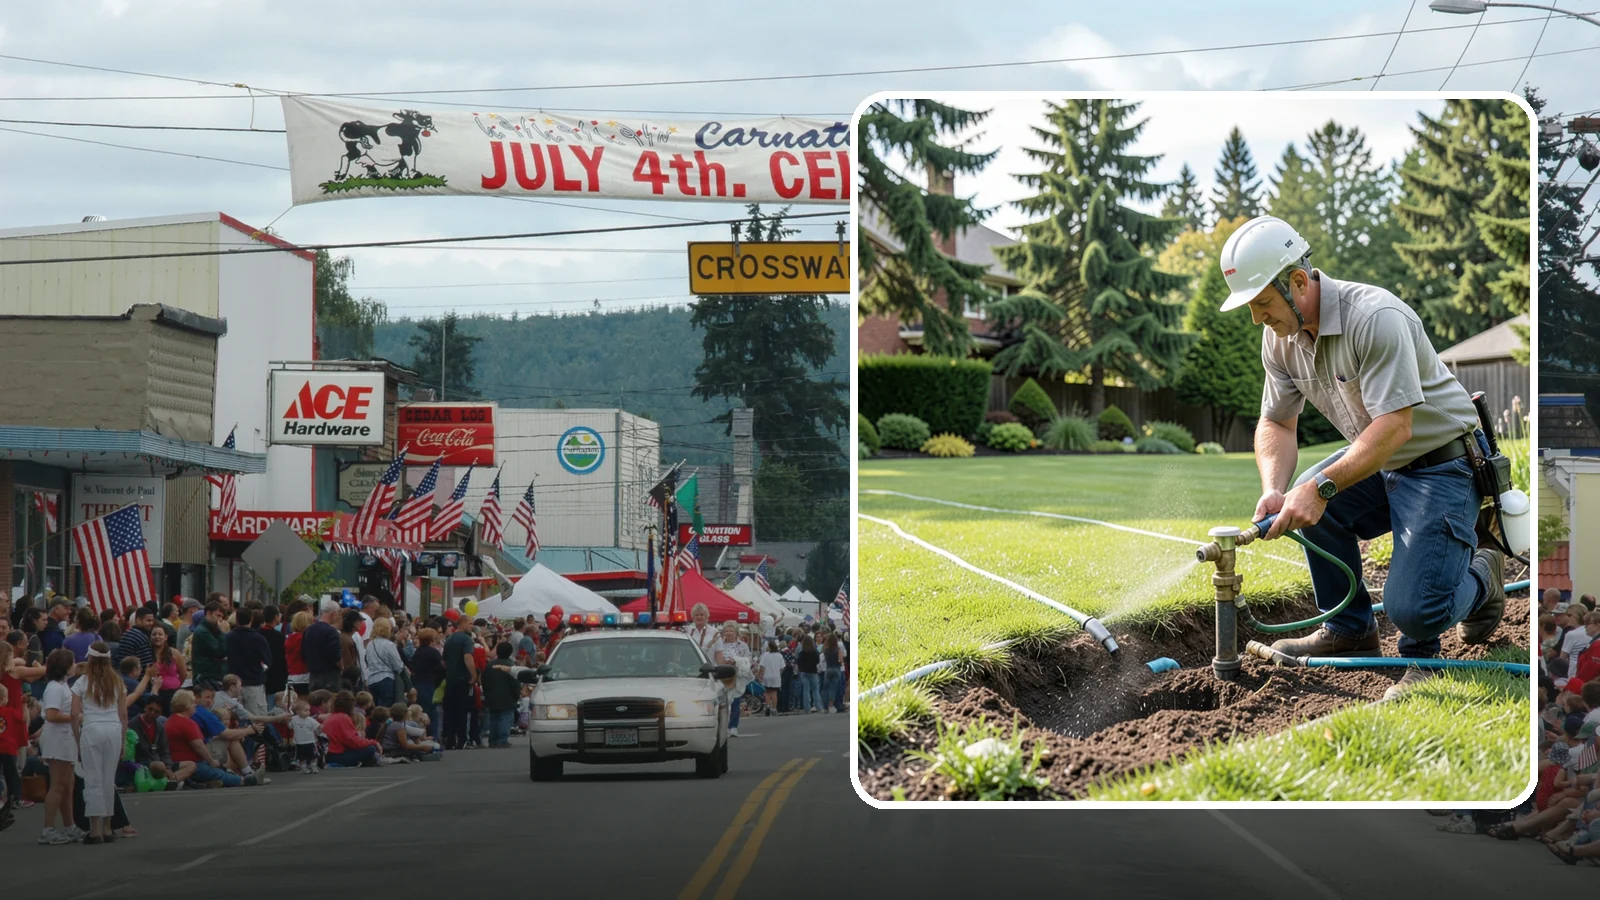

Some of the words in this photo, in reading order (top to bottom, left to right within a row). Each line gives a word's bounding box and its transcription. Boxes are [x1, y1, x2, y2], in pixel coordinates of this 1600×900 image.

[695, 121, 850, 150] Carnat
[481, 141, 605, 192] JULY
[632, 149, 746, 198] 4th.
[697, 254, 850, 280] CROSSWA
[283, 380, 373, 420] ACE
[406, 410, 453, 422] CEDAR
[461, 410, 485, 422] LOG
[283, 421, 371, 437] Hardware
[416, 428, 477, 447] Coca-Cola
[353, 467, 387, 480] Simpl
[83, 485, 94, 494] St.
[95, 485, 124, 495] Vincent
[126, 486, 136, 495] de
[137, 485, 155, 495] Paul
[212, 516, 330, 536] HARDARE
[688, 526, 742, 535] CRNATION
[699, 535, 731, 544] GLASS
